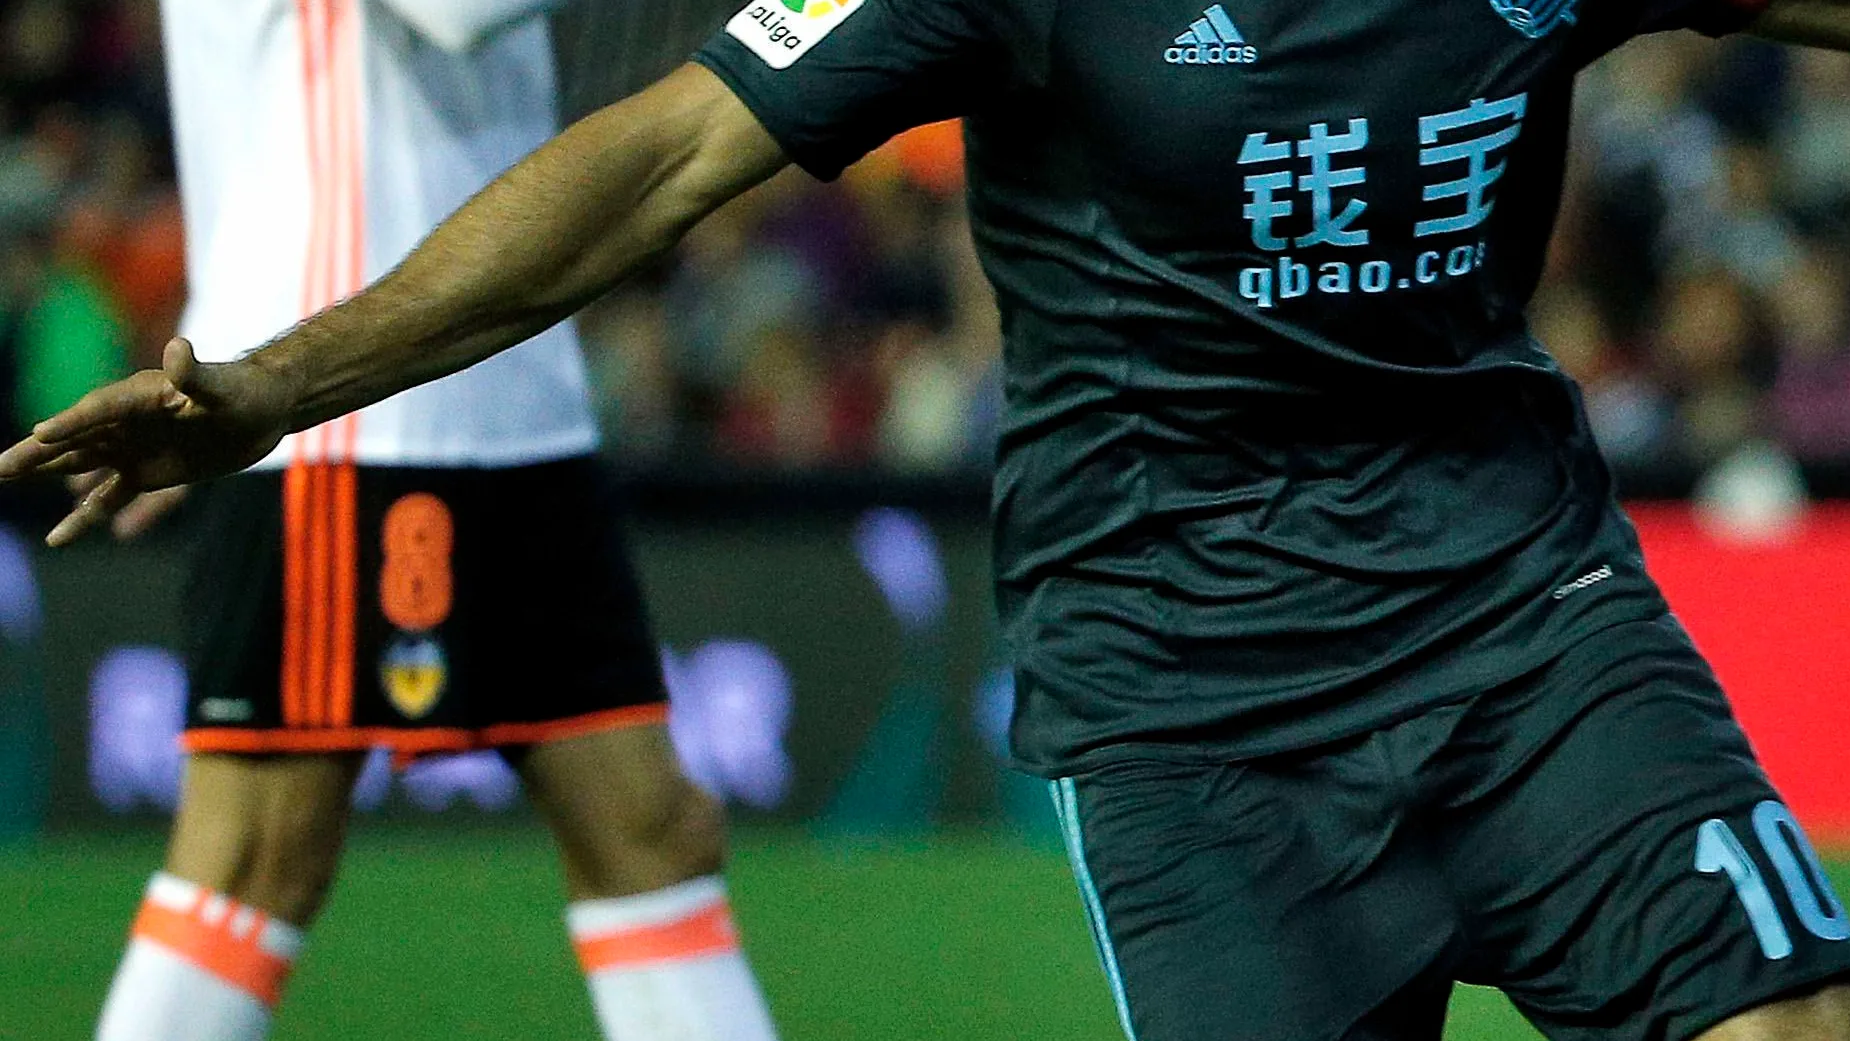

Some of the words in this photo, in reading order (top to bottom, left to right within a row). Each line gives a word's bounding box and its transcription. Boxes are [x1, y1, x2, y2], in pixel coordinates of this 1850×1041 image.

[747, 5, 802, 50] aLiga
[1163, 41, 1257, 65] adidas
[1238, 242, 1485, 307] qbao.co
[380, 493, 454, 629] 8
